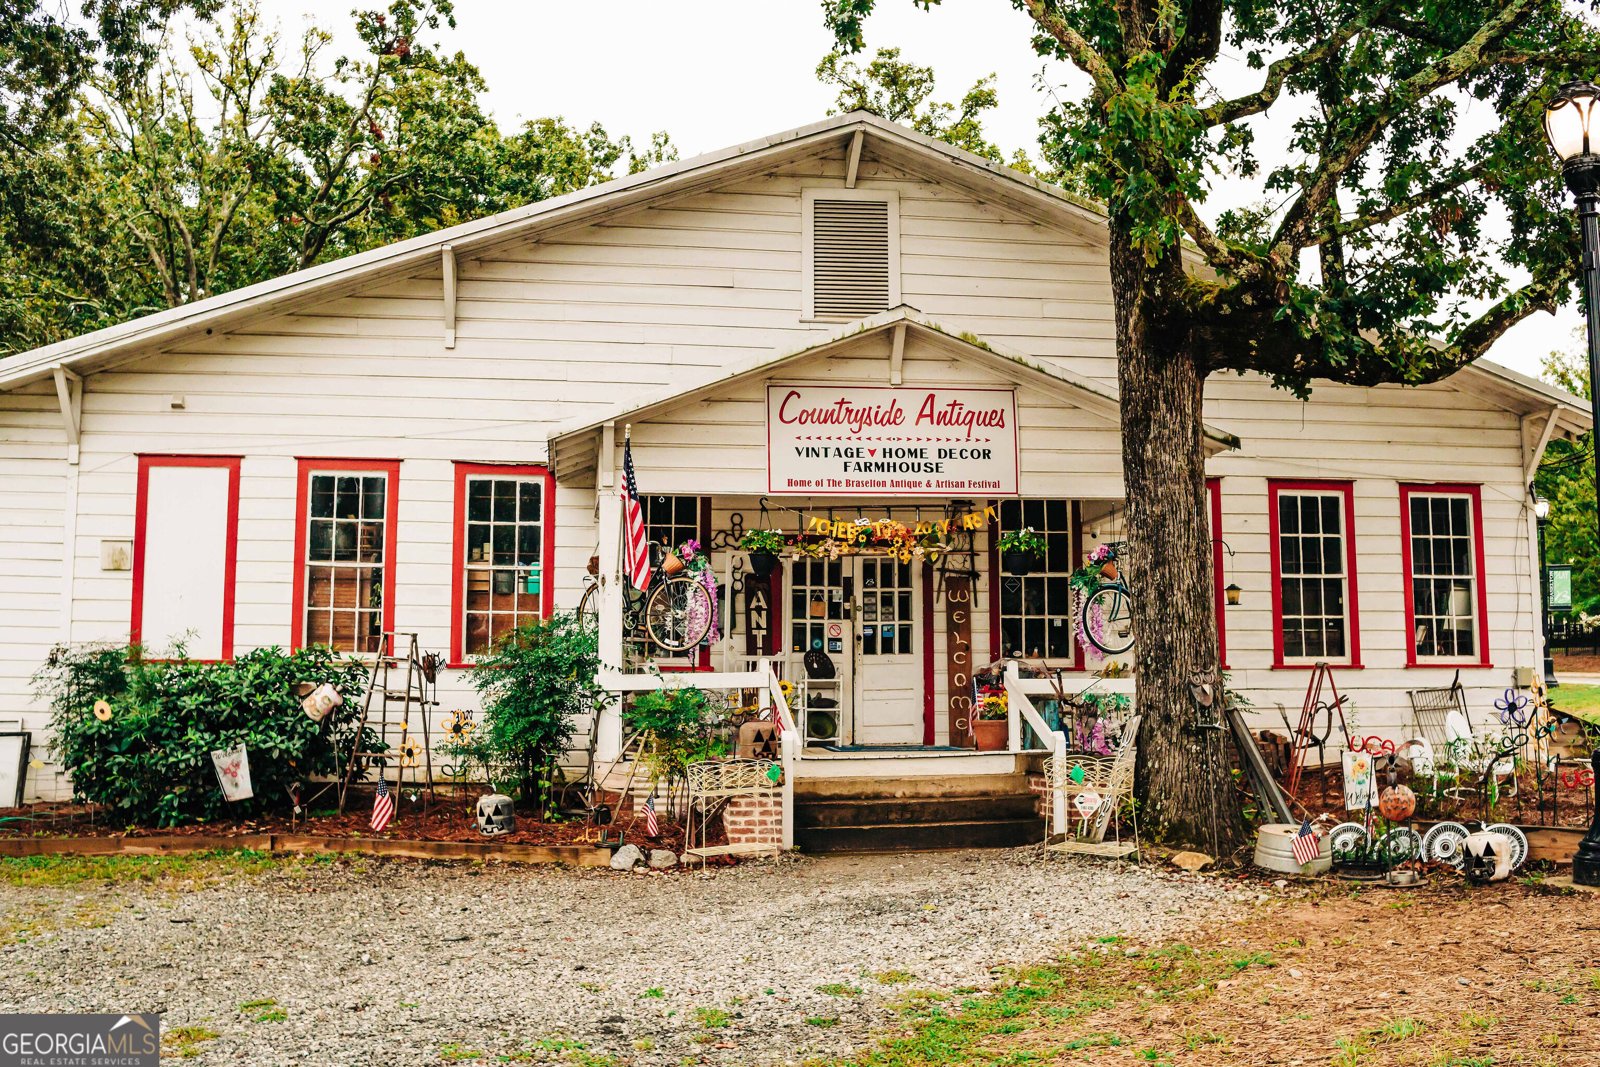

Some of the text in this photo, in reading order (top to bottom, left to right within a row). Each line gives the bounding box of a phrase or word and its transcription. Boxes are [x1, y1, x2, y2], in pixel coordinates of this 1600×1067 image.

[778, 390, 1005, 438] Countryside Antiques
[795, 446, 992, 460] VINTAGE HOME DECOR
[843, 461, 945, 474] FARMHOUSE
[787, 478, 1001, 489] Home of The Braselton Antique & Artisan Festival
